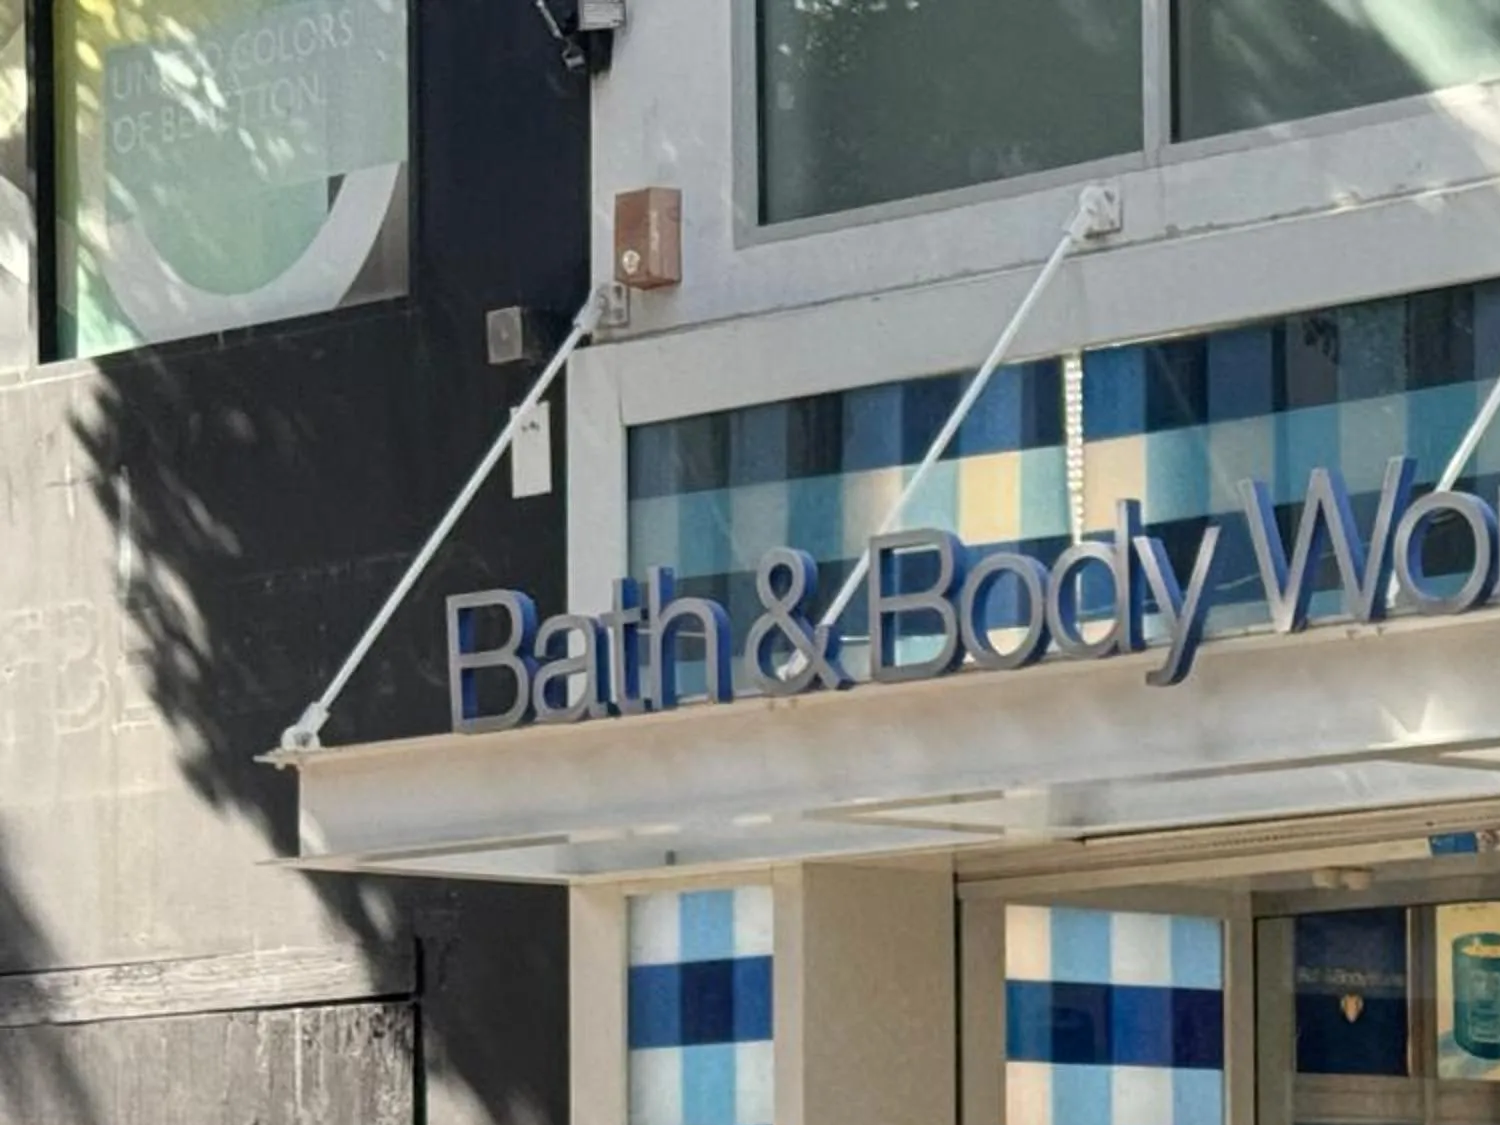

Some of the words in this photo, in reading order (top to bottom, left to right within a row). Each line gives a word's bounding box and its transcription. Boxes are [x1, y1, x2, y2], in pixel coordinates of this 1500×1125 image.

[230, 8, 354, 71] COLORS
[113, 110, 154, 154] OF
[445, 565, 733, 734] Bath
[744, 547, 856, 695] &
[869, 498, 1220, 687] Body
